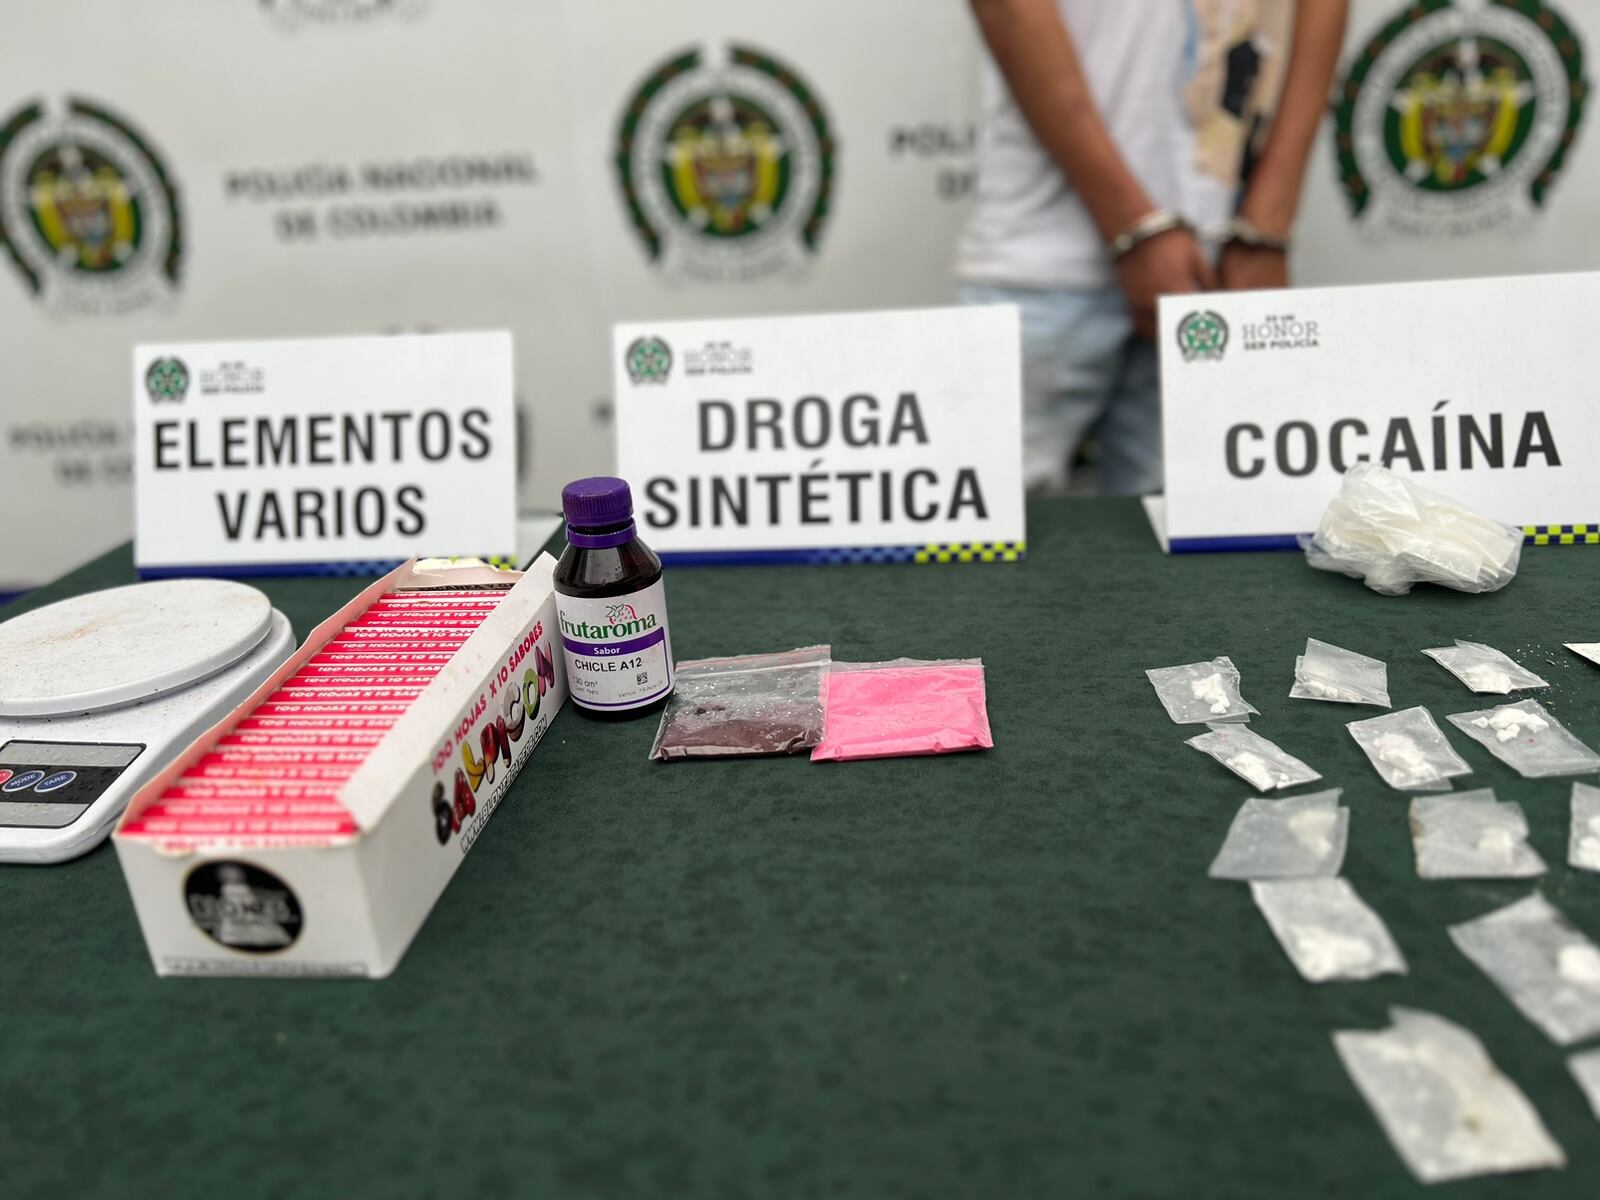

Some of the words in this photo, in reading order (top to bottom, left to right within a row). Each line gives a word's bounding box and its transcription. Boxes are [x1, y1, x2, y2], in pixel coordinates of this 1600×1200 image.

[1242, 321, 1319, 340] HONOR
[154, 408, 492, 470] ELEMENTOS
[698, 393, 930, 452] DROGA
[1225, 400, 1562, 479] COCAÍNA
[217, 485, 426, 540] VARIOS
[644, 459, 989, 529] SINTÉTICA
[560, 610, 657, 639] frutaroma
[575, 659, 616, 672] CHICLE
[620, 657, 642, 671] A12
[594, 646, 620, 655] Sabor
[432, 740, 454, 776] 100
[455, 693, 487, 740] HOJAS
[489, 680, 497, 698] X
[497, 665, 508, 690] 10
[509, 620, 544, 672] SABORES
[10, 774, 37, 787] MODE
[43, 774, 67, 786] TARE
